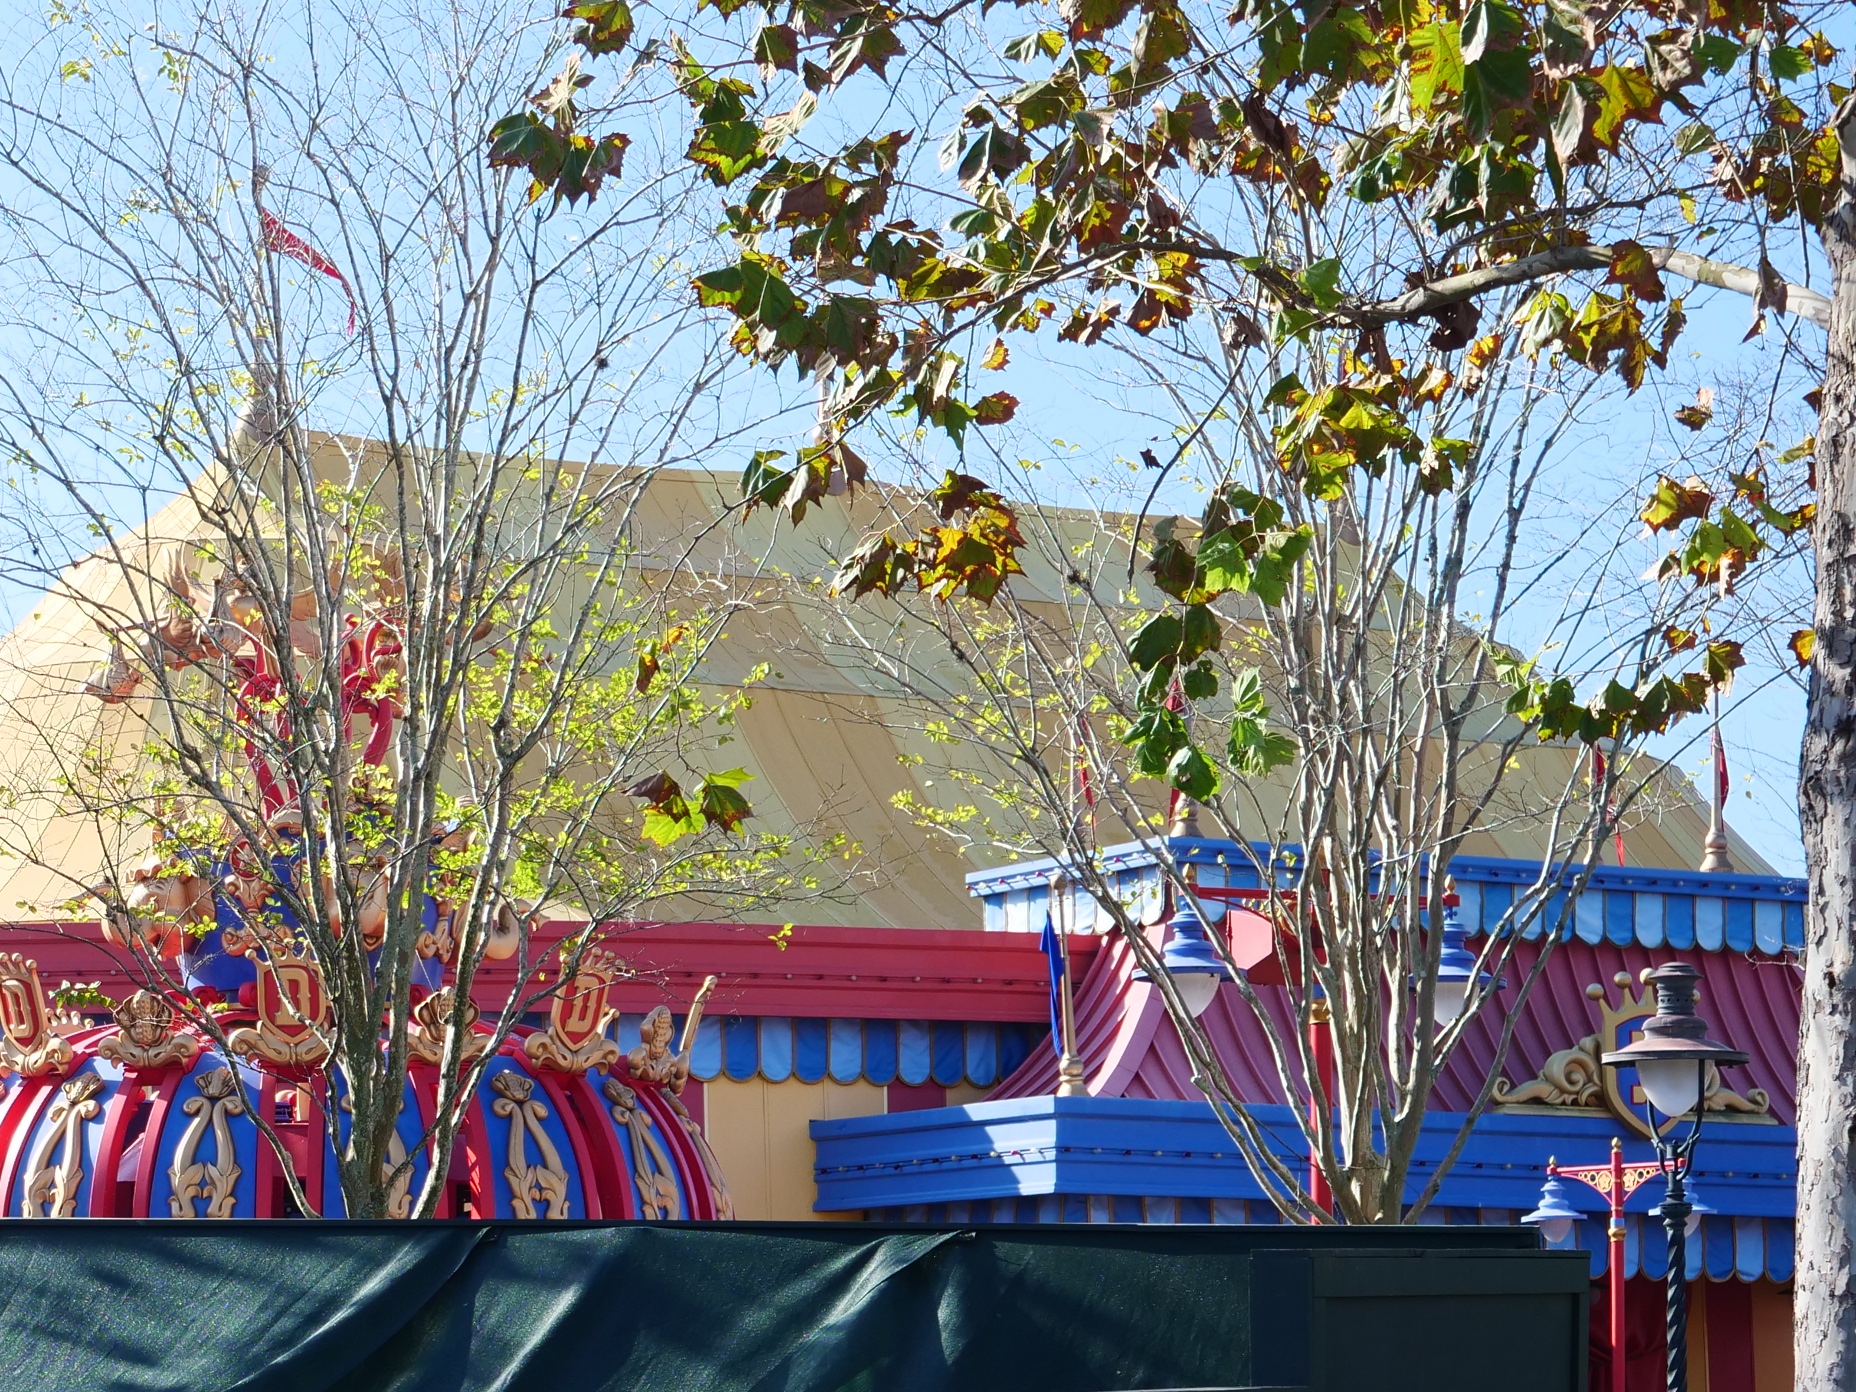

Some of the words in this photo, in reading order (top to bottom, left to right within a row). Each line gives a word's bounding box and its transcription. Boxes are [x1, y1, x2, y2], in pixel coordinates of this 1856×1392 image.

[2, 980, 34, 1038] D
[275, 968, 311, 1025] D
[565, 975, 600, 1033] D
